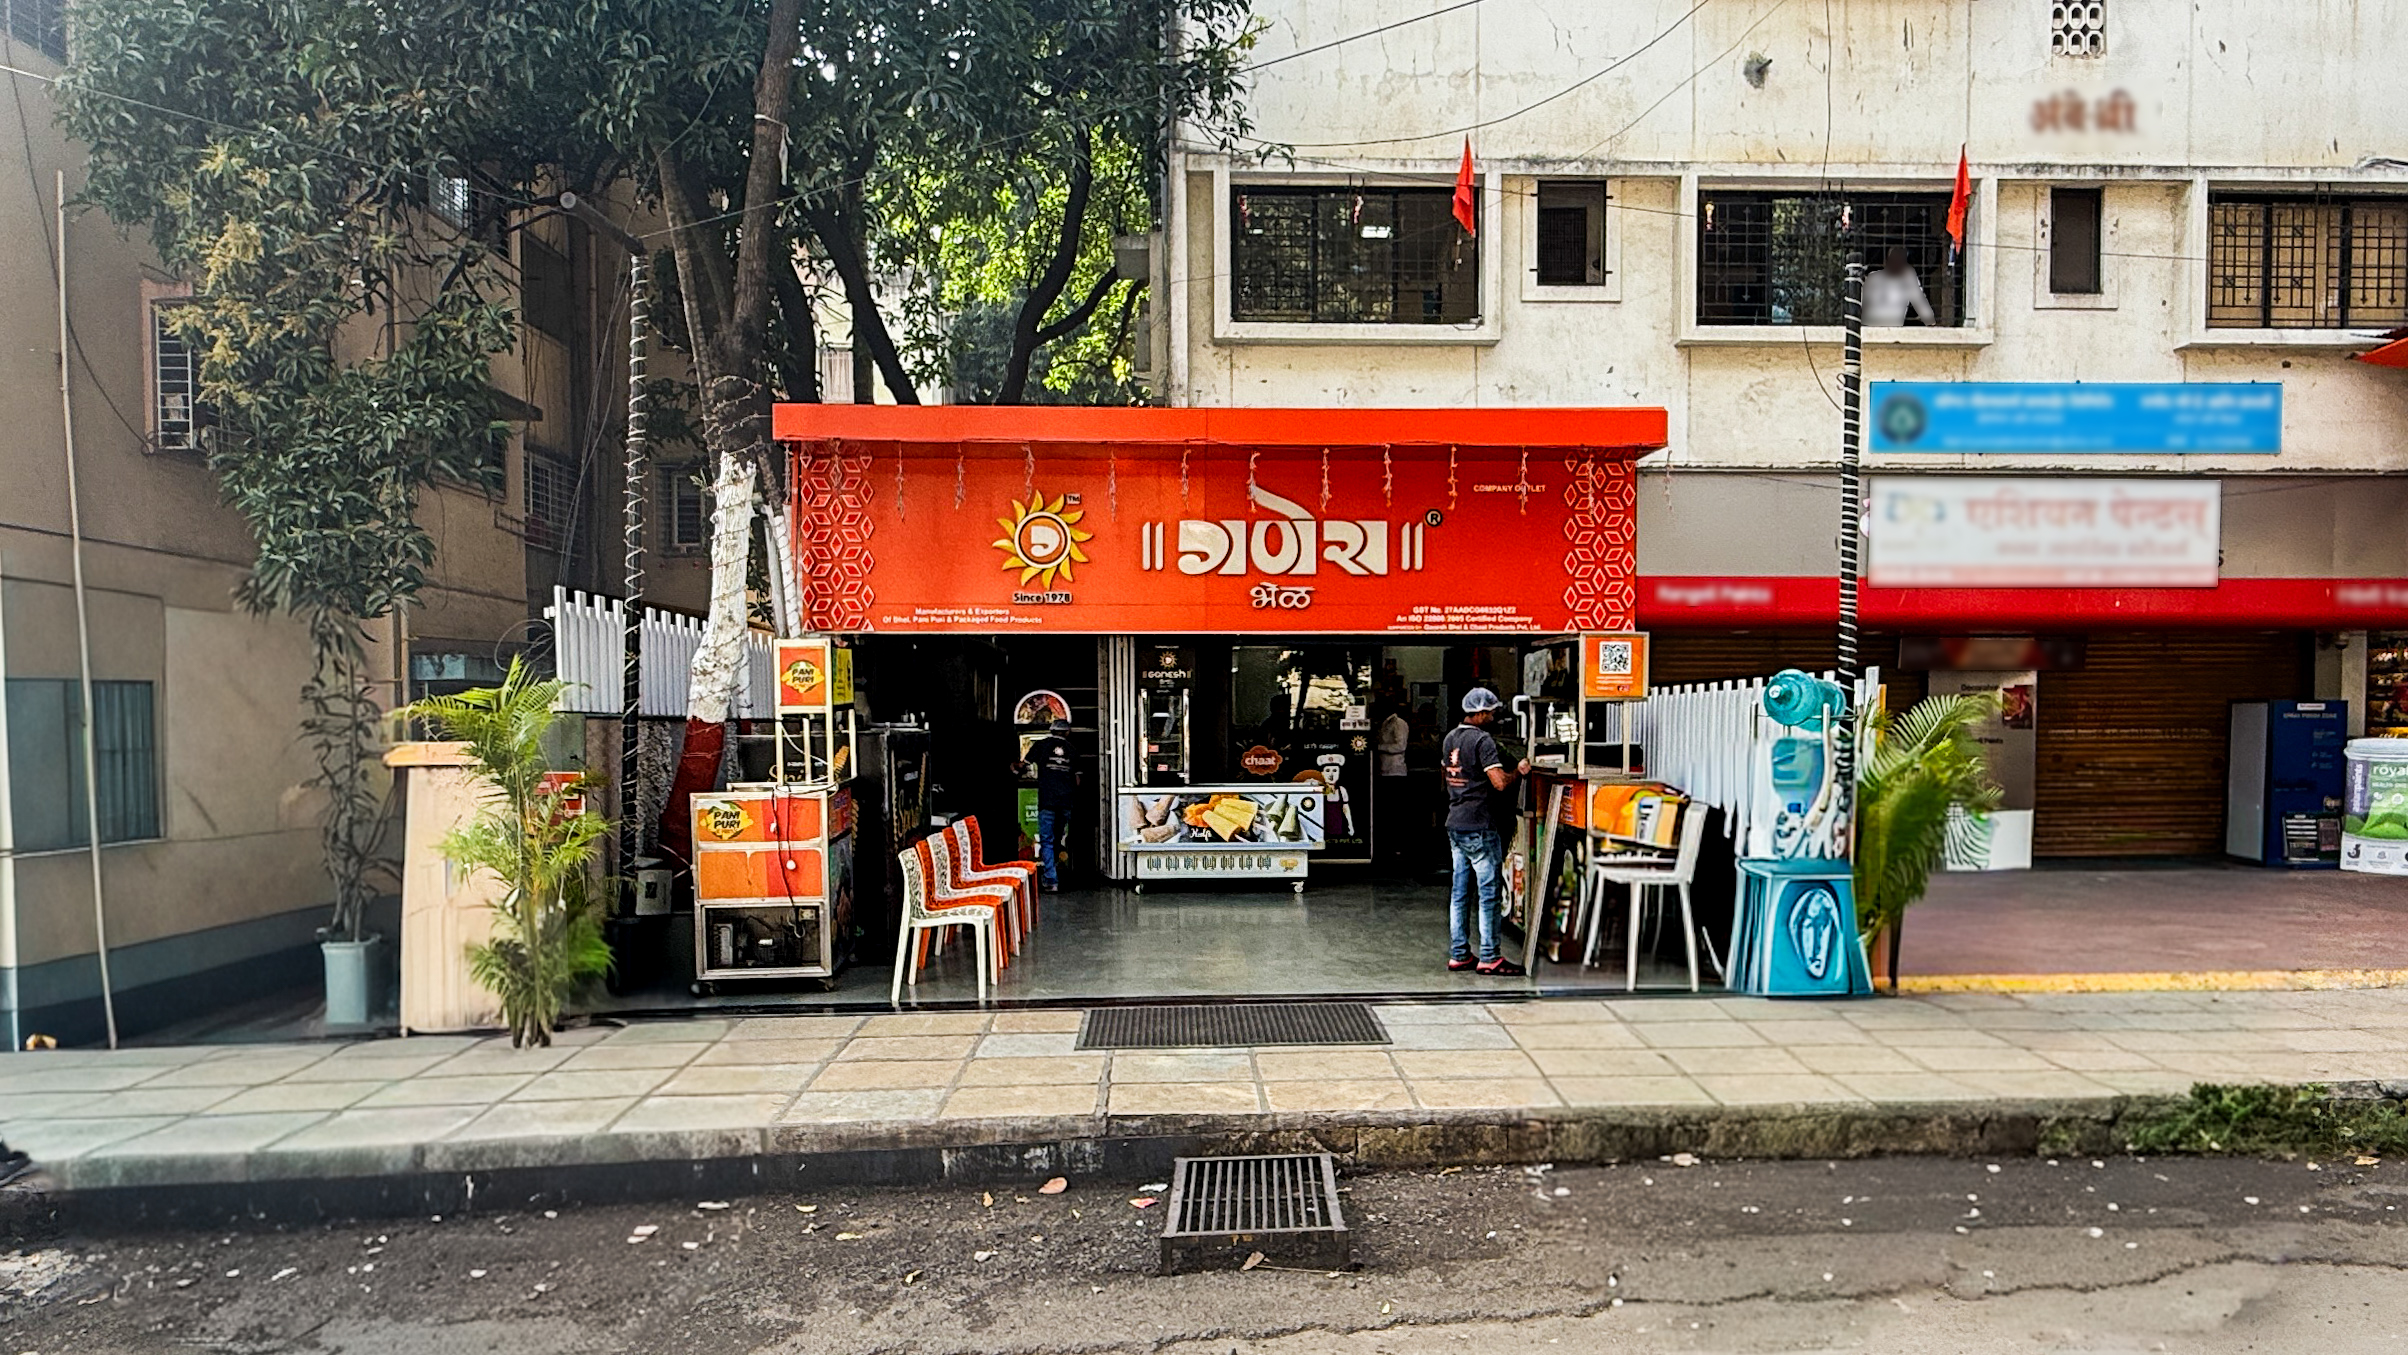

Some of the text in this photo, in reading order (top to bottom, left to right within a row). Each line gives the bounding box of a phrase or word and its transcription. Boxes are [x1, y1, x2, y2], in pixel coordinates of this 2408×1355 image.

[1473, 484, 1546, 493] COMPANY OTLET
[1013, 592, 1072, 603] Since 1978
[791, 668, 815, 676] PANI
[791, 676, 815, 684] PURI
[1244, 755, 1277, 766] chaat
[713, 810, 741, 819] PANI
[713, 820, 741, 829] PURI
